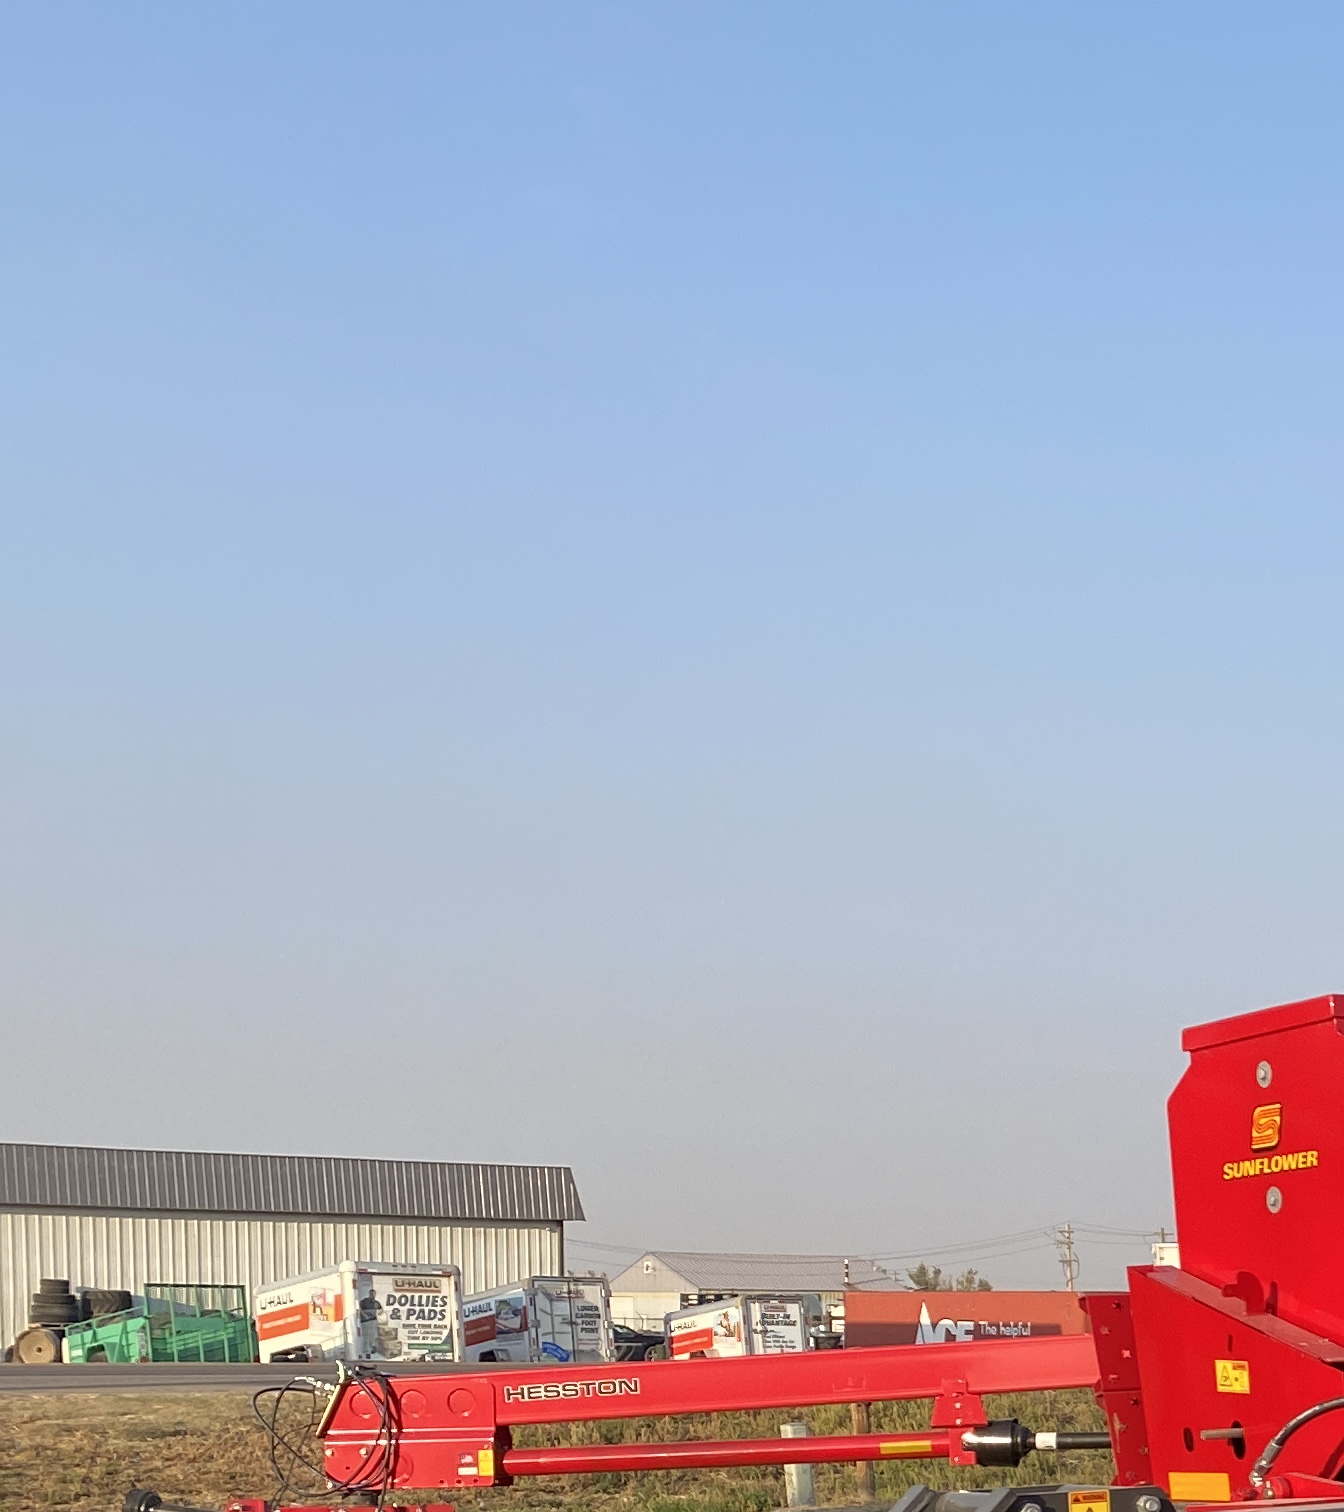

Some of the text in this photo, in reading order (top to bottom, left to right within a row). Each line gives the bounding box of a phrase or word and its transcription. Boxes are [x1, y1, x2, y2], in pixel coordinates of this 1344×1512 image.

[1223, 1150, 1318, 1180] SUNFLOWER
[394, 1280, 440, 1288] U-HAUL
[260, 1292, 294, 1310] U-HAUL
[386, 1294, 448, 1307] DOLLIES
[390, 1308, 446, 1321] & PADS
[463, 1302, 493, 1318] U-HAUL
[979, 1321, 997, 1335] The
[1000, 1321, 1031, 1337] helpful
[504, 1378, 640, 1403] HESSTON
